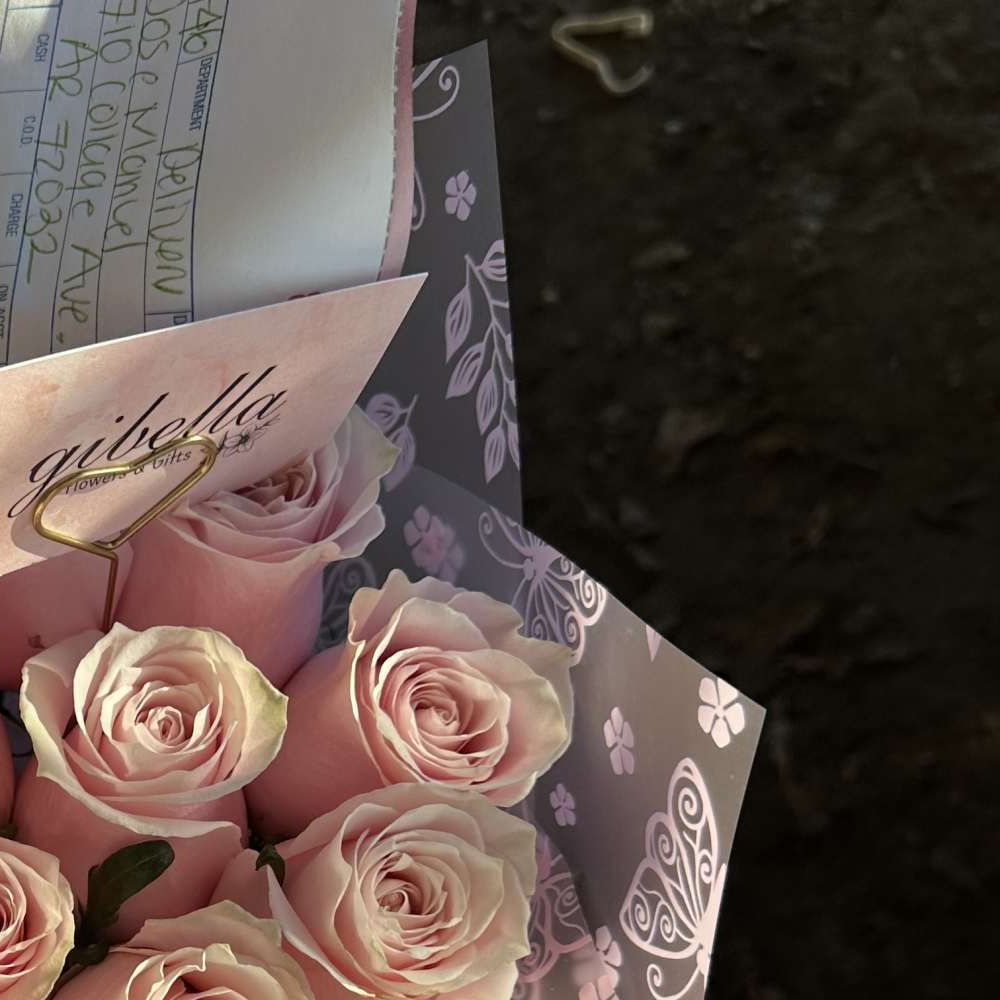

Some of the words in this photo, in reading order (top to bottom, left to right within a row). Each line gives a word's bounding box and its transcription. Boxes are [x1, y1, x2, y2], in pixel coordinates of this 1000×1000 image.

[34, 34, 50, 62] CASH
[49, 39, 98, 101] AR
[189, 56, 213, 131] DEPARTMENT
[19, 115, 37, 148] C.O.D.
[6, 193, 24, 237] CHARGE
[24, 120, 69, 284] 72032
[7, 365, 287, 518] gibella
